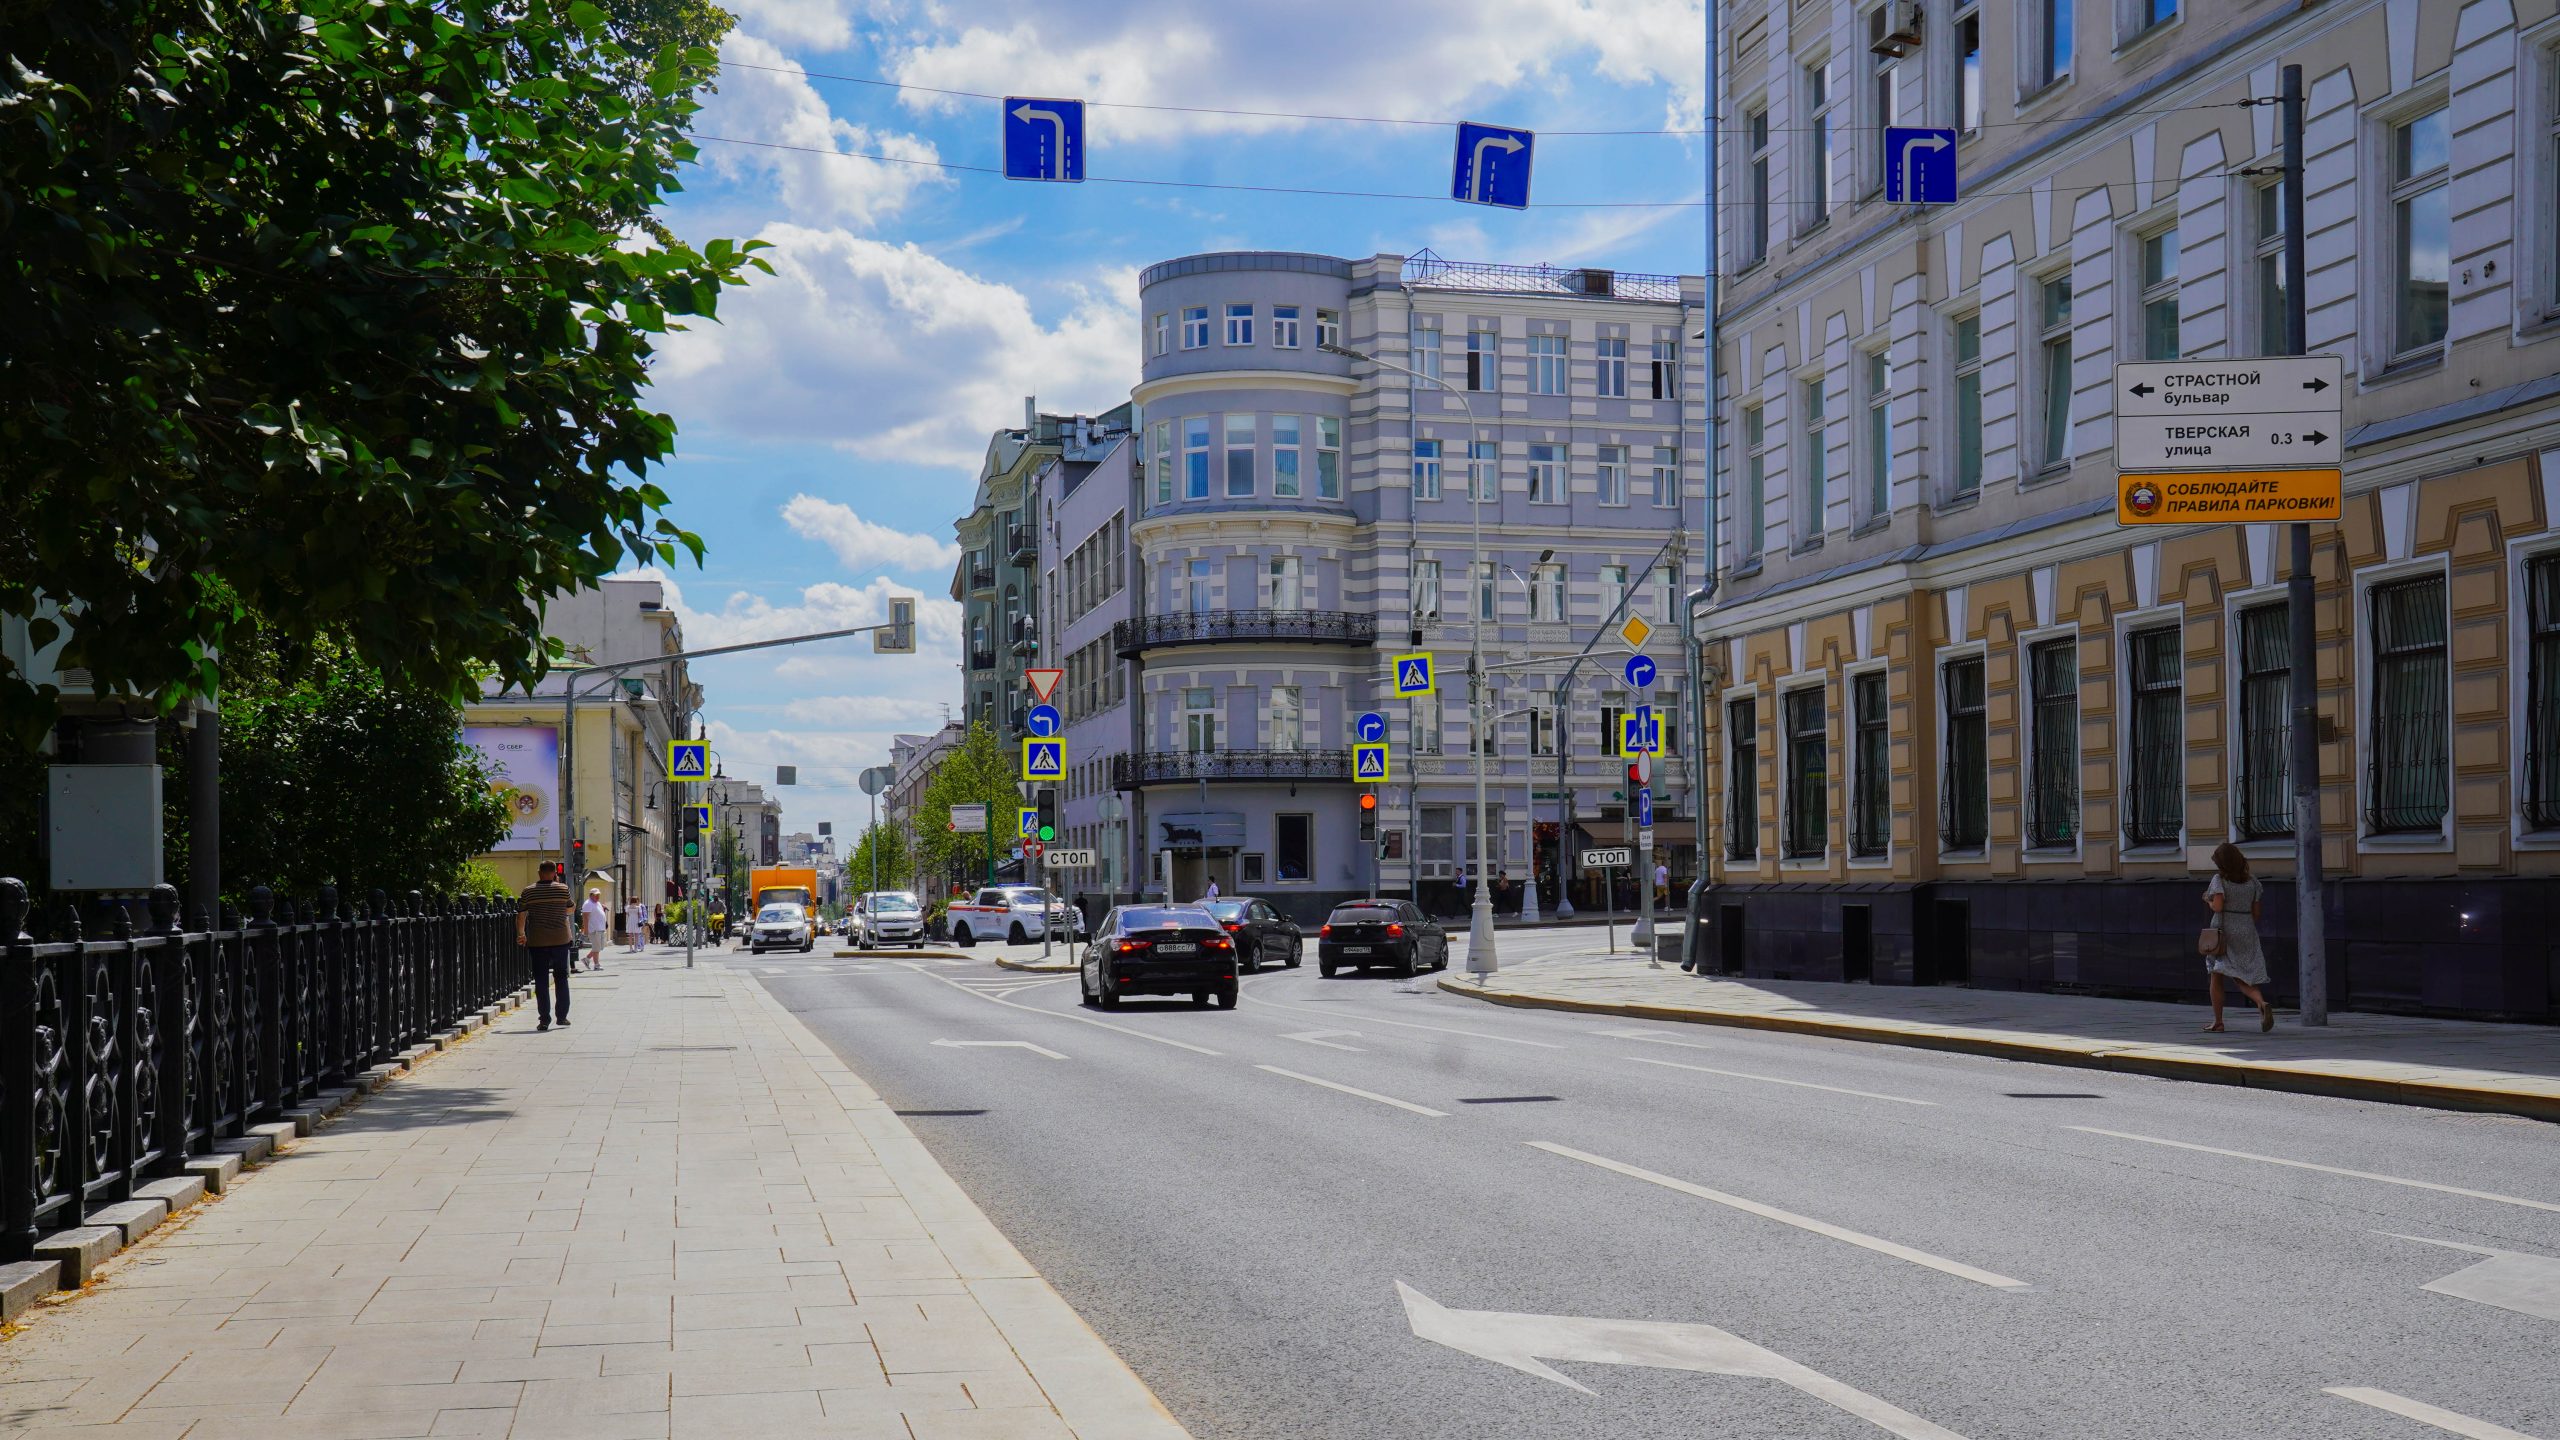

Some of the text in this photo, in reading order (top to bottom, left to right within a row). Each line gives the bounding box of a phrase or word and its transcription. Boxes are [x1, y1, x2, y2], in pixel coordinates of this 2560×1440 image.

[2164, 370, 2260, 388] СТРАСТНОЙ
[2164, 391, 2230, 406] бульвар
[2165, 425, 2250, 439] ТВЕРСКАЯ
[2271, 433, 2293, 445] 0.3
[2165, 444, 2212, 458] улица
[2167, 480, 2279, 497] СОБЛЮДАЙТЕ
[2167, 497, 2335, 513] ПРАВИЛА ПАРКОВКИ!
[1050, 852, 1088, 865] СТОП
[1588, 851, 1625, 864] СТОП
